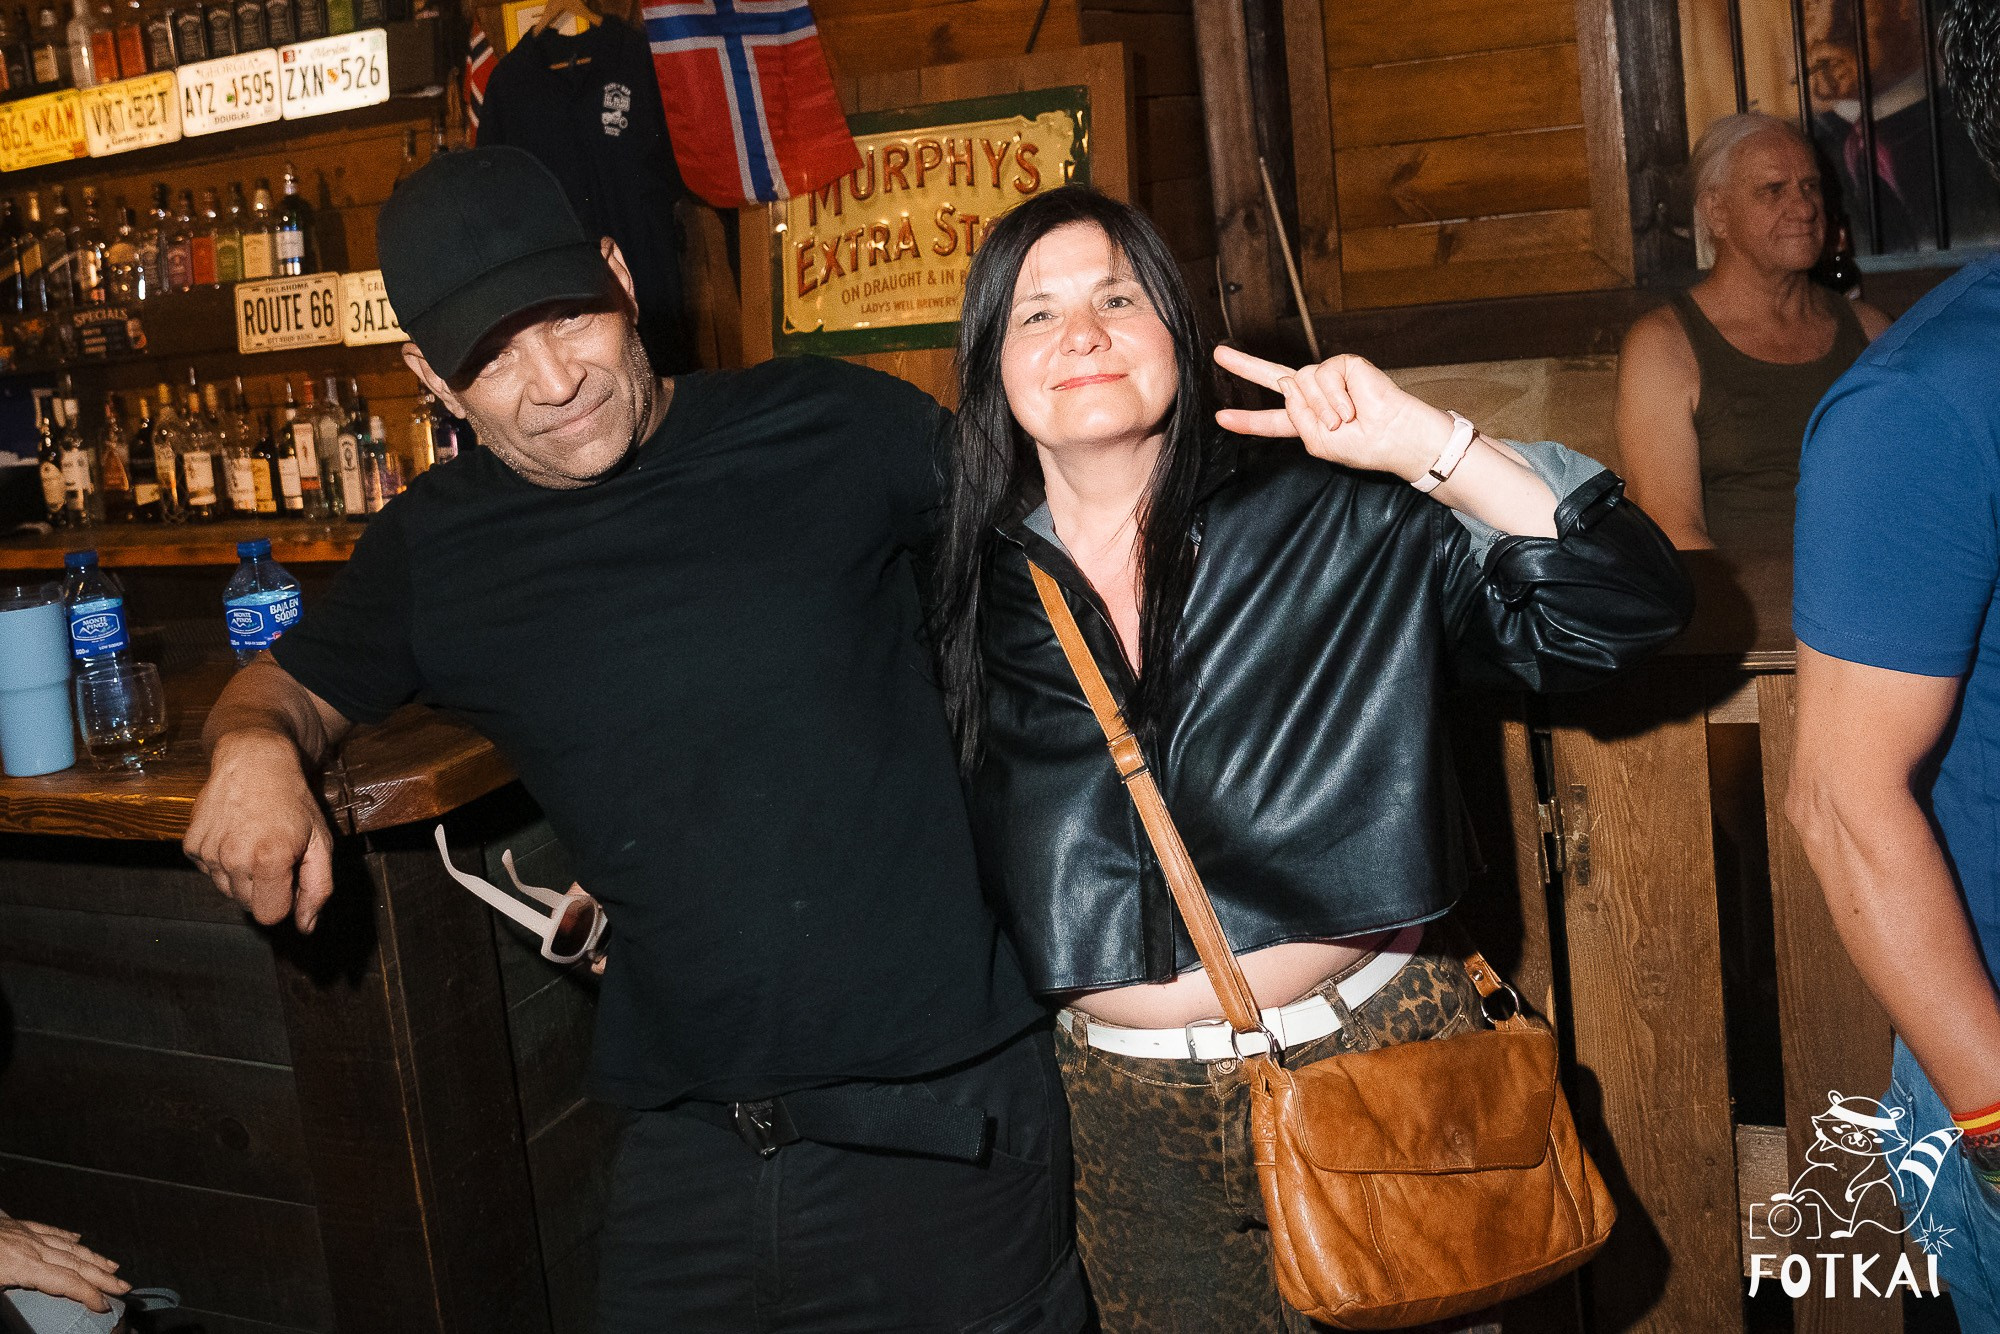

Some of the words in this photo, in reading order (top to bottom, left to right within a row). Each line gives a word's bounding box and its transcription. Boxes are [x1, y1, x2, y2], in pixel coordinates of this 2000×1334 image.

[185, 82, 216, 118] AYZ
[232, 70, 275, 108] 1595
[285, 64, 325, 101] ZXN
[340, 54, 380, 91] 526
[796, 210, 921, 299] EXTRA
[841, 285, 860, 305] ON
[863, 270, 922, 298] DRAUGHT
[927, 269, 937, 286] &
[941, 268, 955, 285] IN
[243, 292, 304, 336] ROUTE
[310, 288, 335, 329] 66
[82, 616, 107, 626] MONTE
[269, 601, 289, 615] BAJA
[289, 597, 299, 609] EN
[274, 607, 298, 623] SODIO
